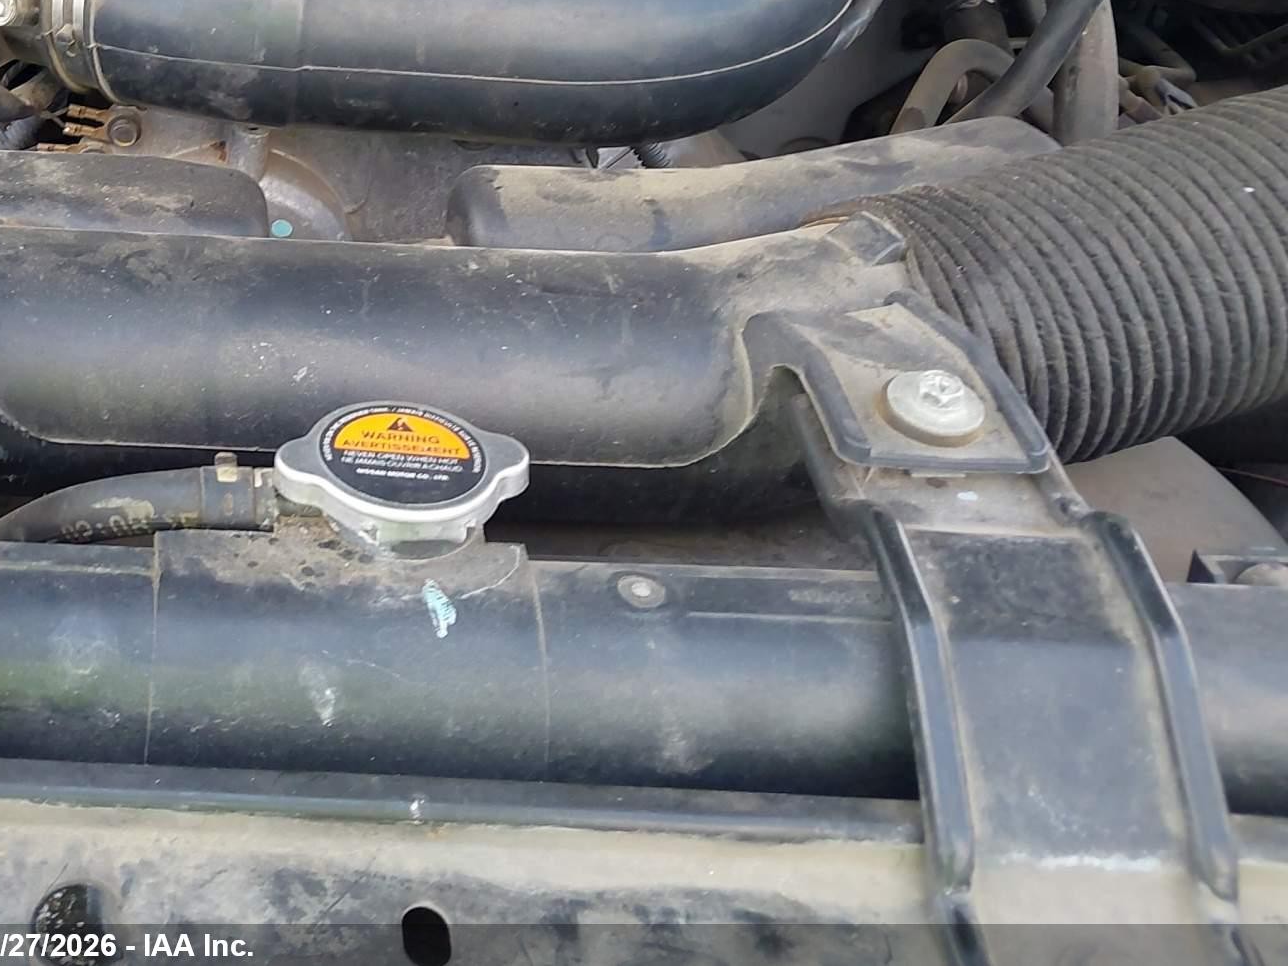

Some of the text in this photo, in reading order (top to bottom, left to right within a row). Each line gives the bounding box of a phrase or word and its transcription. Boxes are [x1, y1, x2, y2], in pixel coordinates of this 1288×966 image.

[361, 430, 441, 445] WARNING
[342, 439, 461, 456] AVERTISSEMENT
[343, 449, 459, 465] NEVER OPEN WHEN HOT
[355, 467, 387, 476] NISSAN
[387, 470, 416, 479] MOTOR
